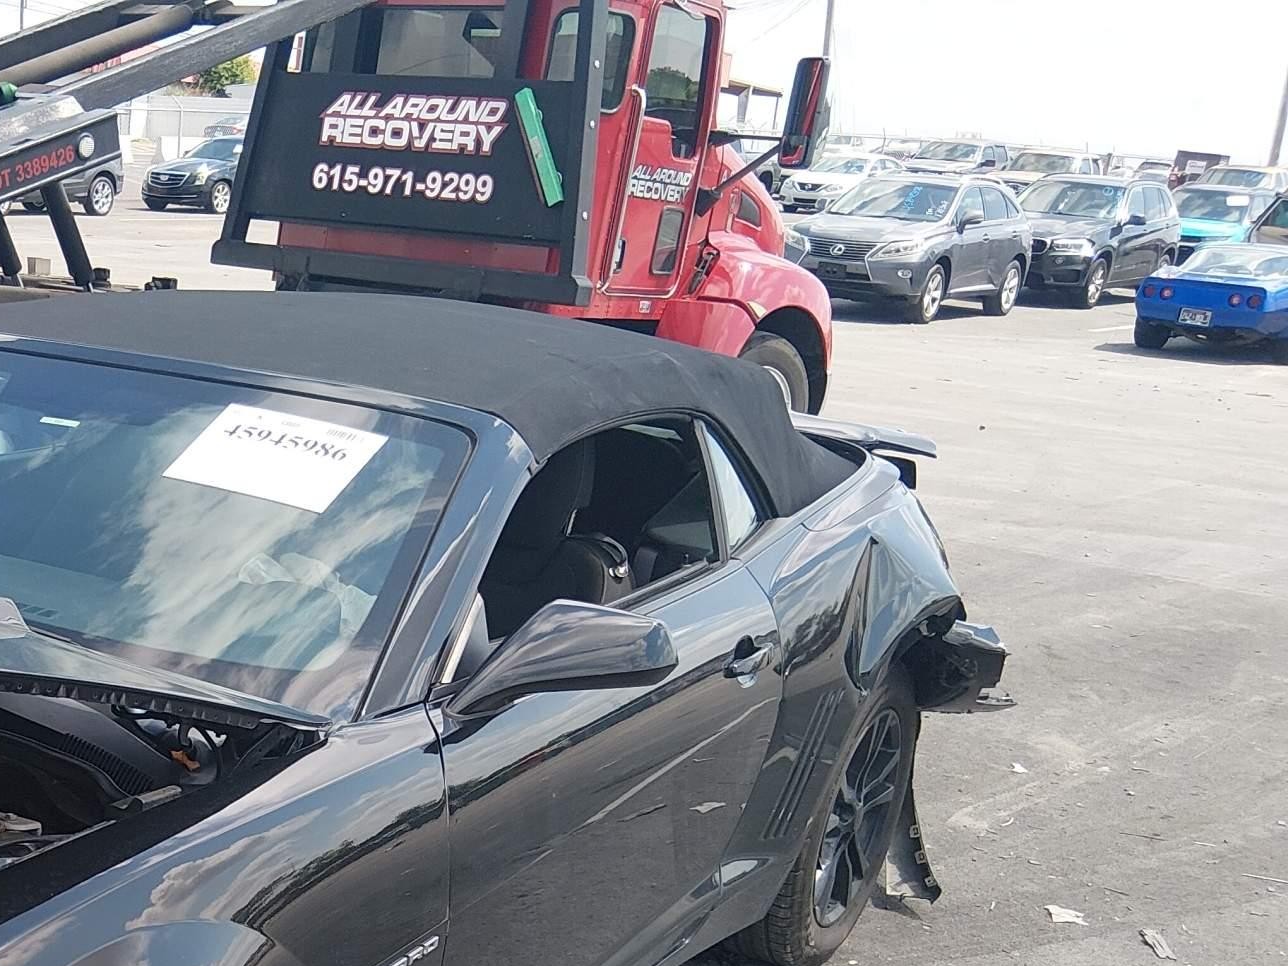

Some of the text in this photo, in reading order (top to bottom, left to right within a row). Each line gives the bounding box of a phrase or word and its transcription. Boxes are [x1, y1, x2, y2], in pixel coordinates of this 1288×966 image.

[323, 92, 509, 124] ALL AROUND
[320, 116, 506, 154] RECOVERY
[14, 144, 76, 183] 3389426
[632, 164, 693, 187] ALL AROUND
[312, 162, 494, 204] 615-971-9299
[627, 179, 691, 204] RECOVERY
[223, 424, 349, 462] 45945986
